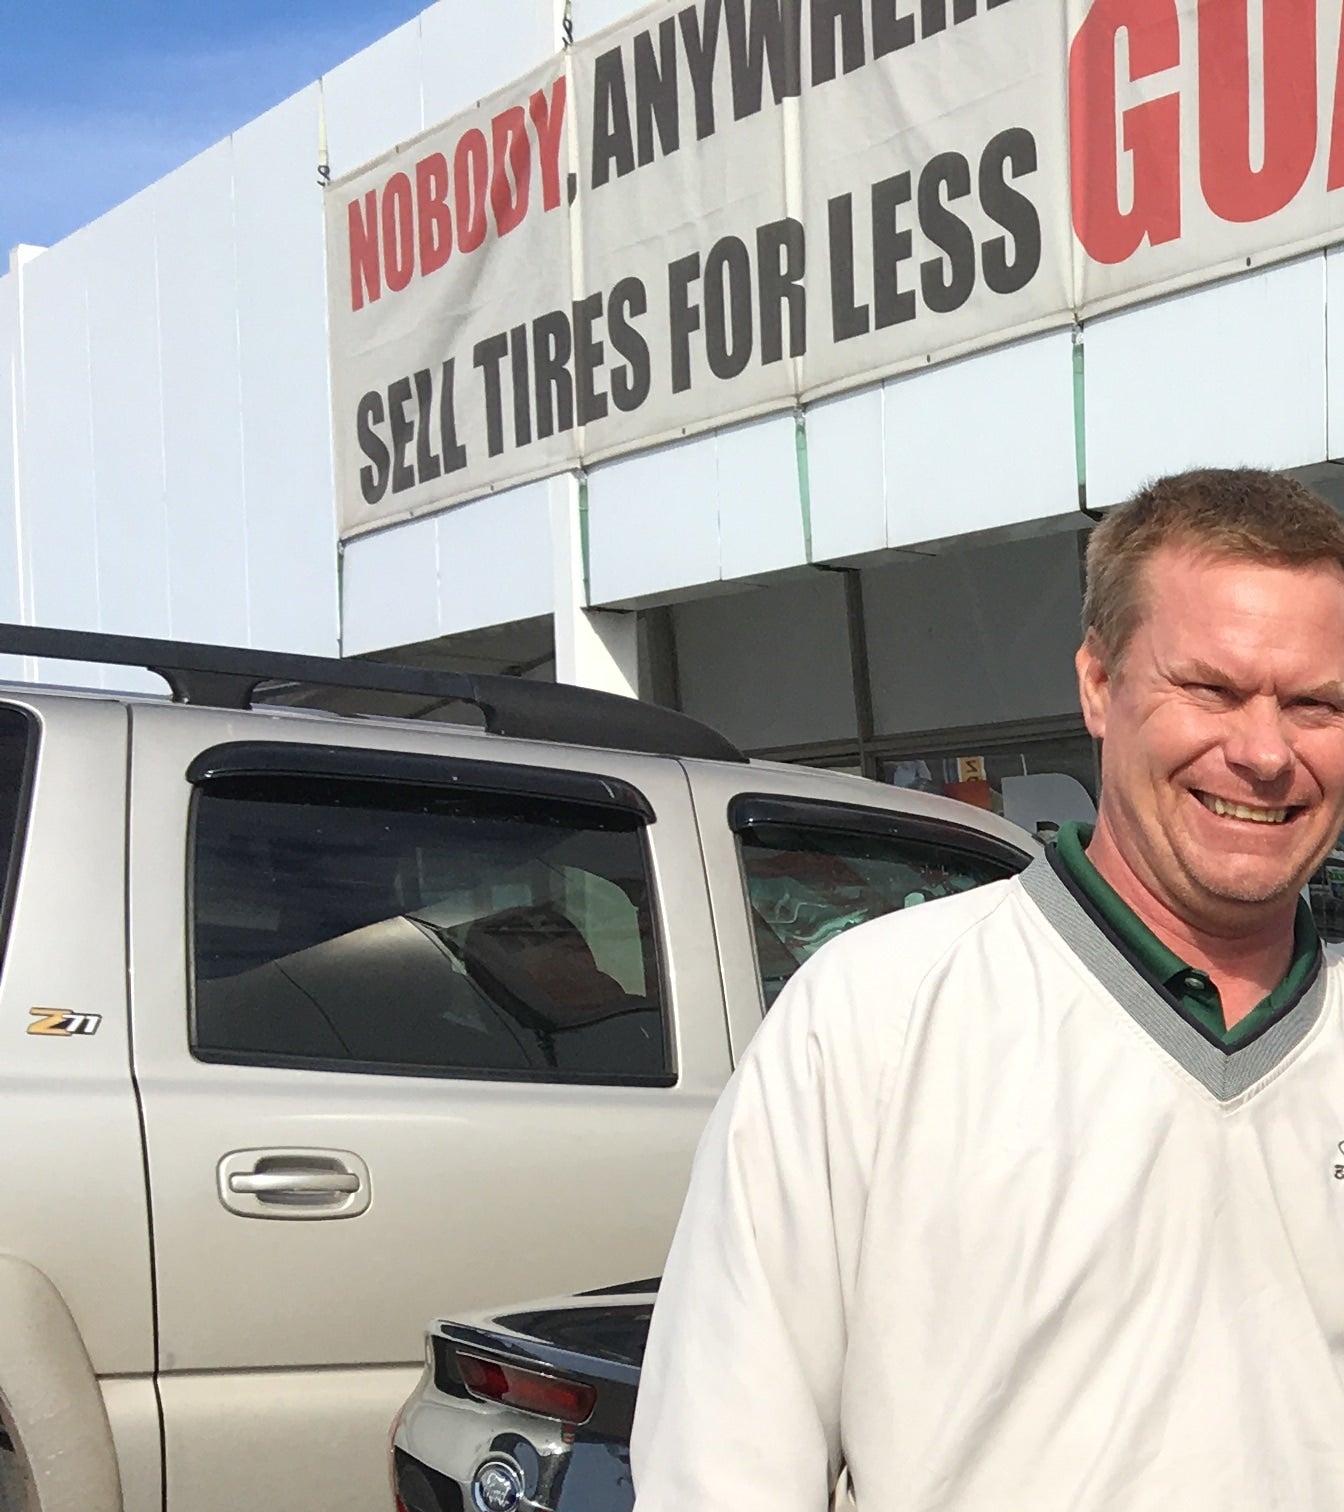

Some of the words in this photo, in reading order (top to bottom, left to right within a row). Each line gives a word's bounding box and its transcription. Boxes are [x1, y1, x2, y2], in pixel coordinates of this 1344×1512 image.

[347, 75, 577, 312] NOBODY,
[356, 358, 467, 506] SELL
[473, 275, 651, 457] TIRES
[668, 216, 806, 393] FOR
[827, 127, 1042, 345] LESS
[26, 1006, 102, 1037] Z71
